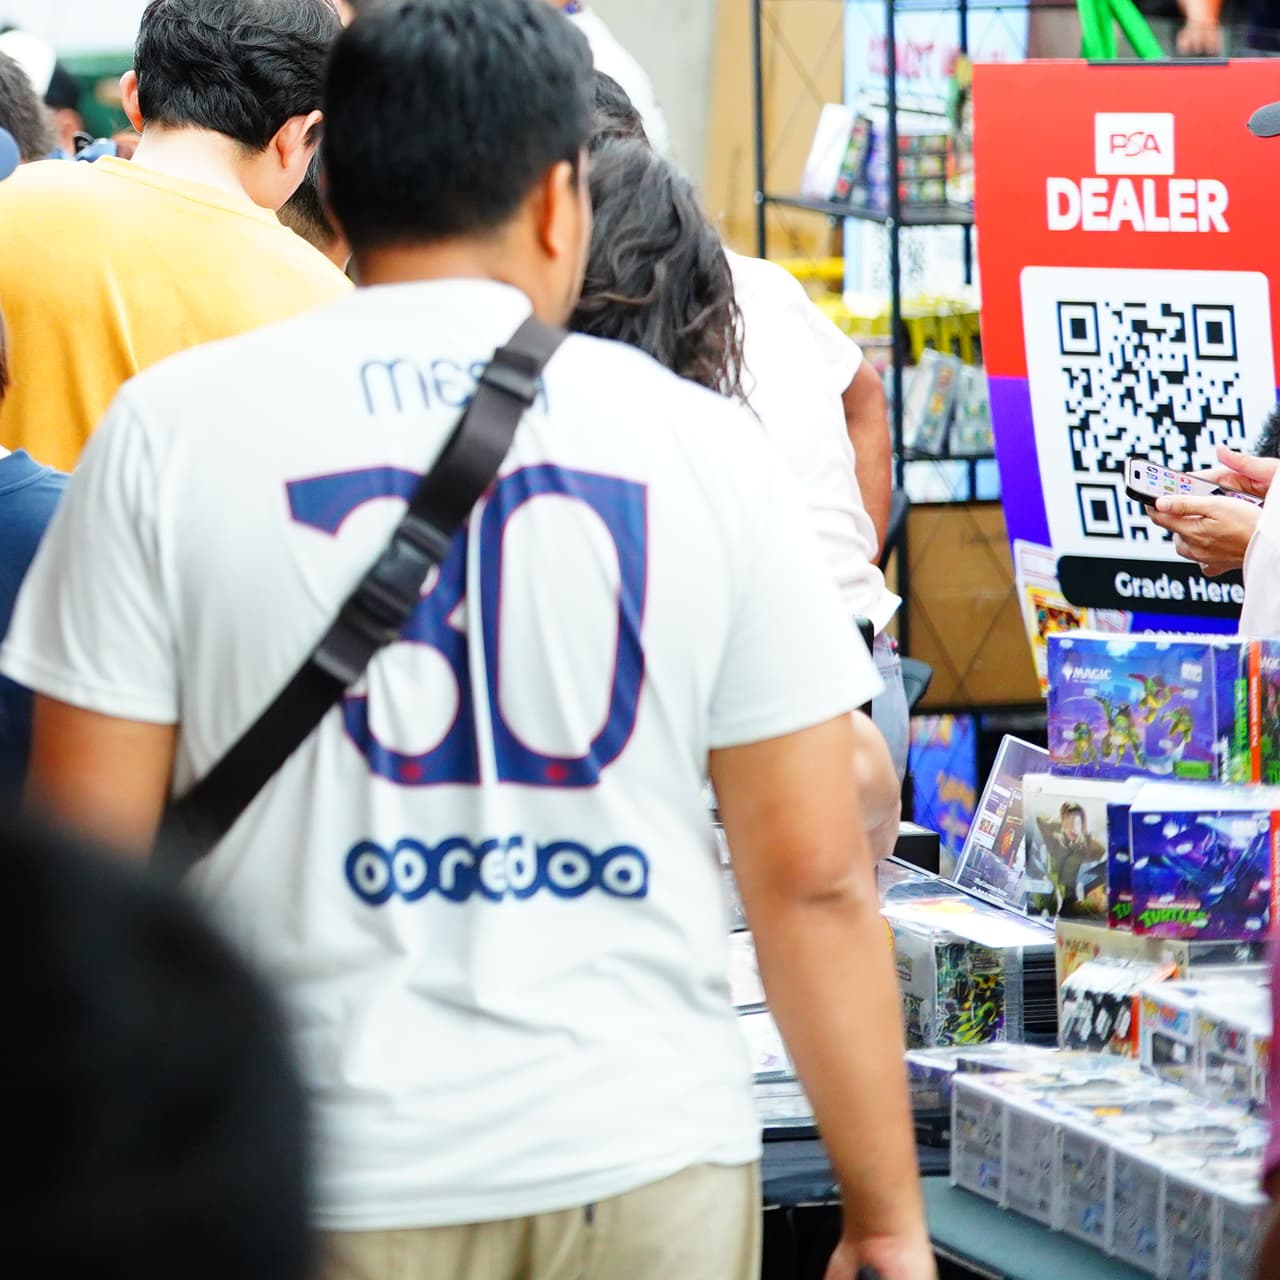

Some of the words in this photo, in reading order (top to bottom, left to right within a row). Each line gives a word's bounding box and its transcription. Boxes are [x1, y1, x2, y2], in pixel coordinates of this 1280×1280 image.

[1109, 131, 1161, 157] PSA
[1046, 176, 1231, 233] DEALER
[1114, 571, 1185, 600] Grade
[1188, 576, 1244, 604] Here
[284, 462, 648, 787] 30
[1072, 666, 1113, 681] MAGIC
[345, 835, 649, 907] ooredoo
